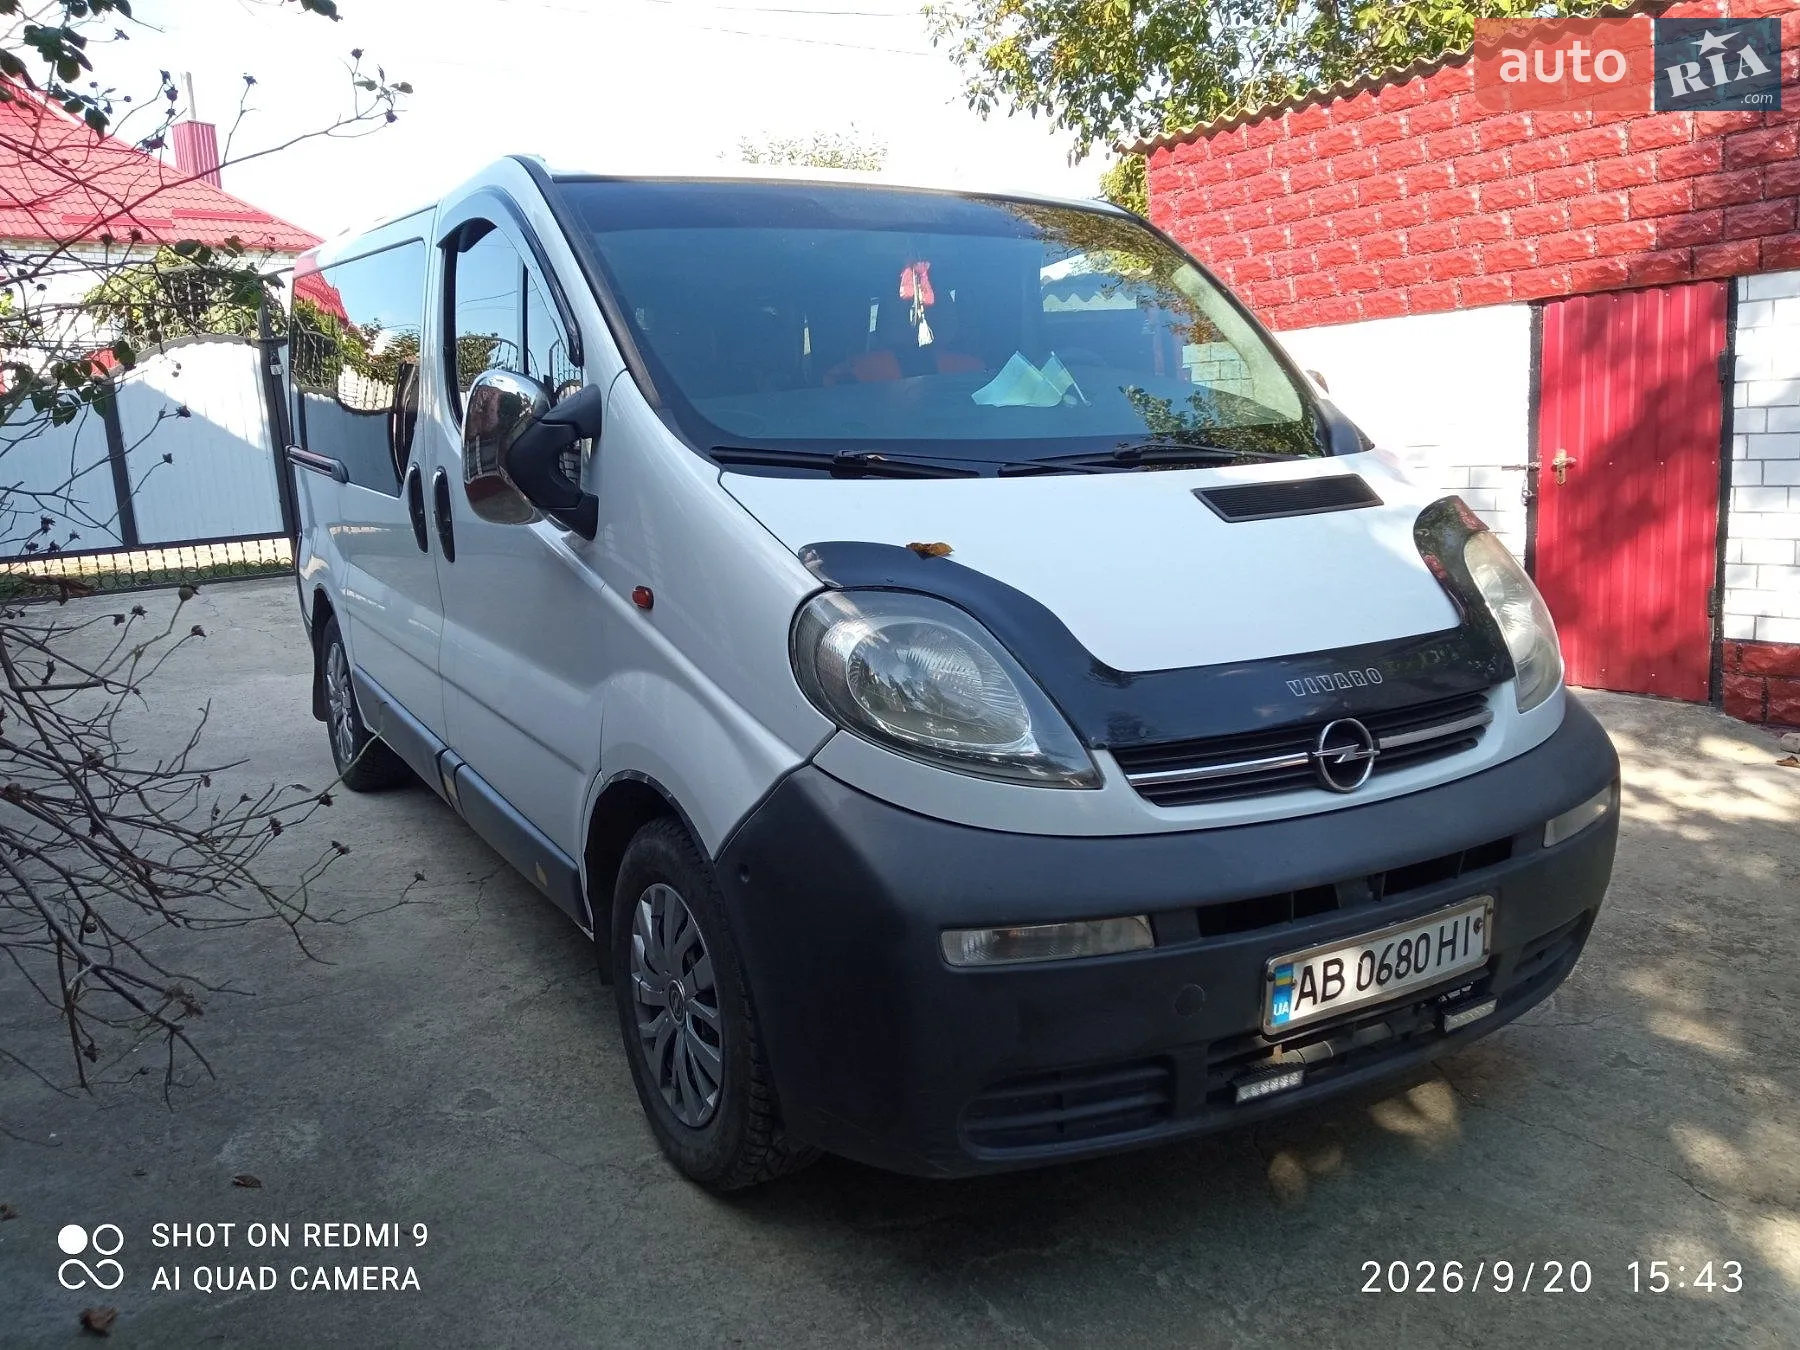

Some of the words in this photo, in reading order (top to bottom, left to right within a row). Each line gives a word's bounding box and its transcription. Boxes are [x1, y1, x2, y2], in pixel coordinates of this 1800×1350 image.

[1286, 667, 1383, 697] VIVARO
[1294, 957, 1345, 1011] AB
[1356, 932, 1431, 992] 0680
[1436, 916, 1471, 966] HI
[1273, 1002, 1290, 1016] UA
